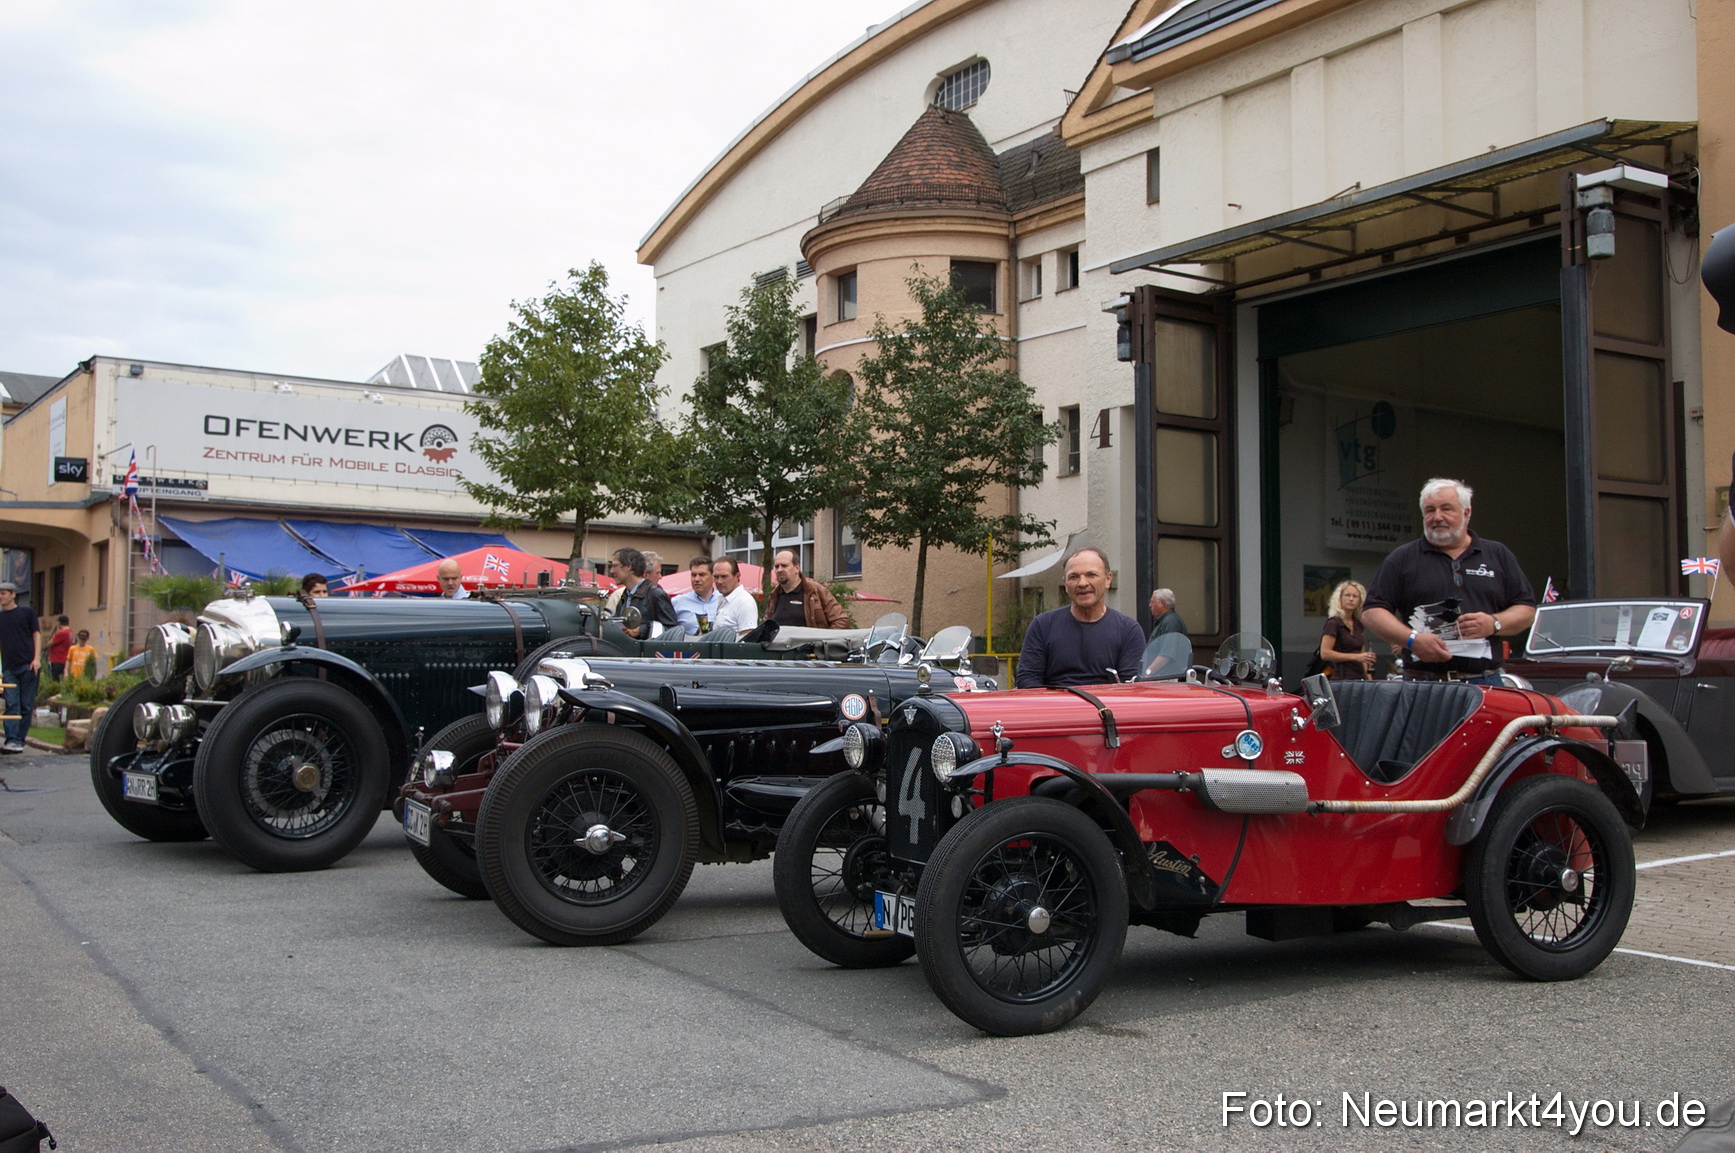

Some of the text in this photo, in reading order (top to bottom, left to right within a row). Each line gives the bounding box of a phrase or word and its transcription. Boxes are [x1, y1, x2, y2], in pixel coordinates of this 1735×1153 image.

[203, 414, 416, 453] OFENWERK
[59, 462, 84, 477] sky
[203, 446, 285, 465] ZENTRUM
[329, 457, 389, 473] MOBILE
[1340, 439, 1376, 471] vtg
[897, 746, 926, 845] 4
[883, 898, 891, 926] N
